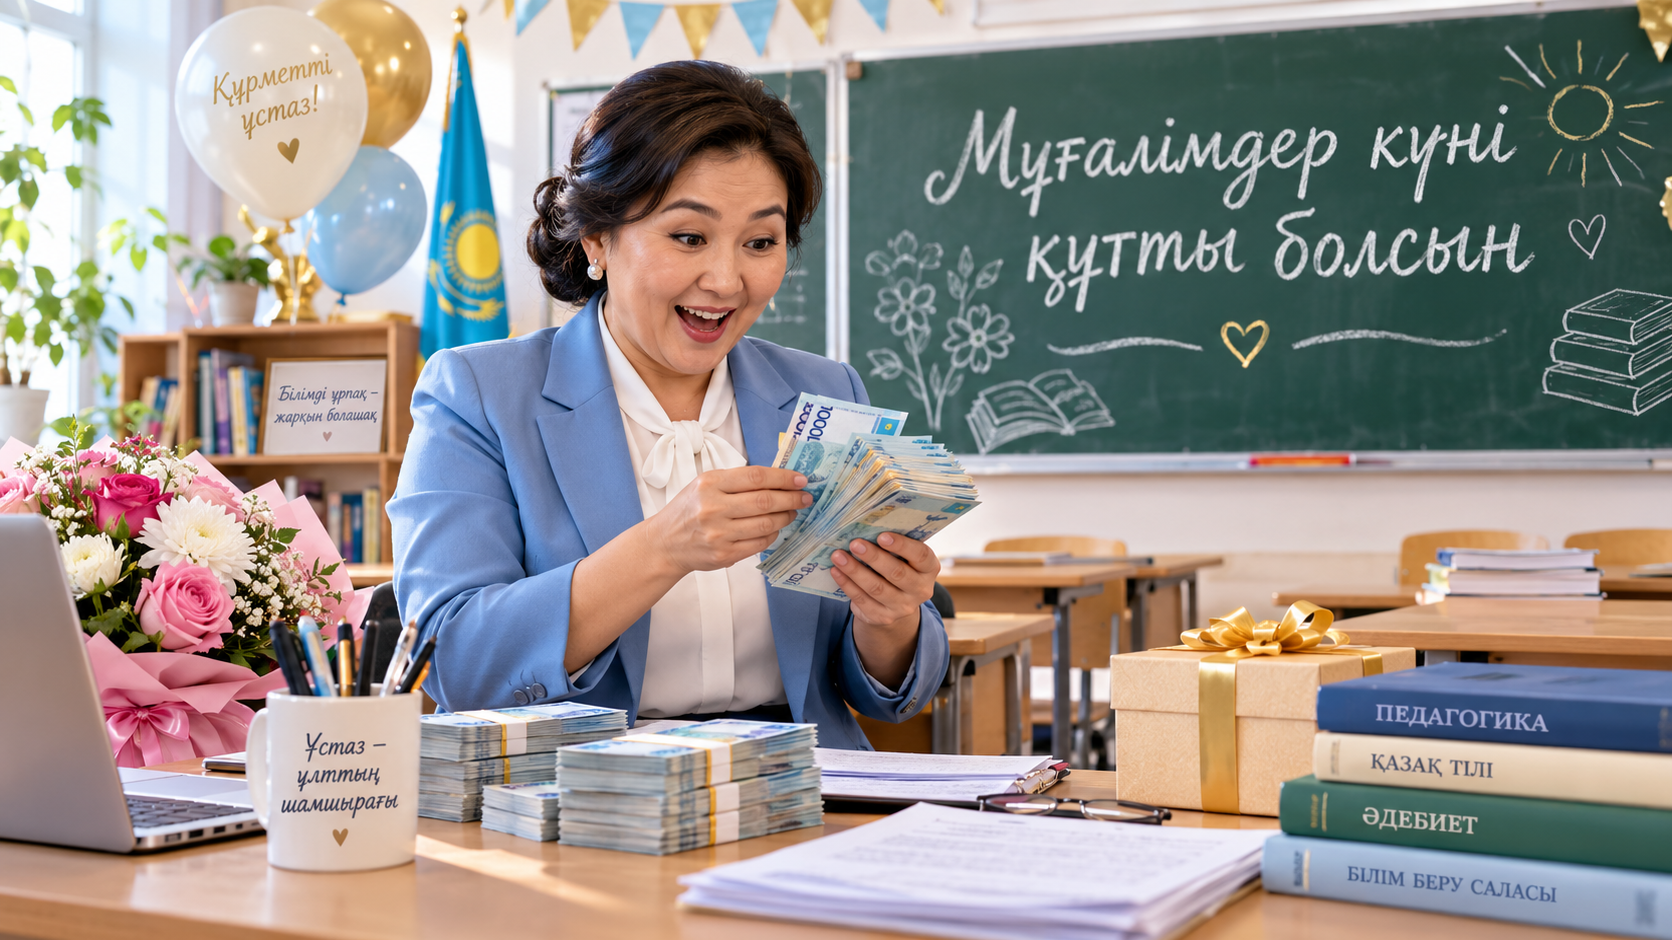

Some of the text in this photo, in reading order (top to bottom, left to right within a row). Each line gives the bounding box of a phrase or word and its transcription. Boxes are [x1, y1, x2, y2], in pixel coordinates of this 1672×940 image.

[213, 53, 333, 107] Құрметті
[241, 84, 318, 140] ұстаз!
[924, 104, 1517, 217] Мұғалімдер күні
[1026, 207, 1535, 312] құтты болсын
[277, 385, 328, 405] Білімді
[331, 389, 367, 405] ұрпақ
[274, 407, 378, 427] жарқын болашақ
[1375, 704, 1549, 733] ПЕДАГОГИКА
[305, 732, 365, 762] Ұстаз
[297, 767, 380, 792] ұлттың
[1370, 753, 1494, 779] ҚАЗАҚ ТІЛІ
[281, 794, 399, 819] шамшырағы
[1362, 806, 1479, 835] ӘДЕБИЕТ
[1346, 866, 1558, 903] БІЛІМ БЕРУ САЛАСЫ
